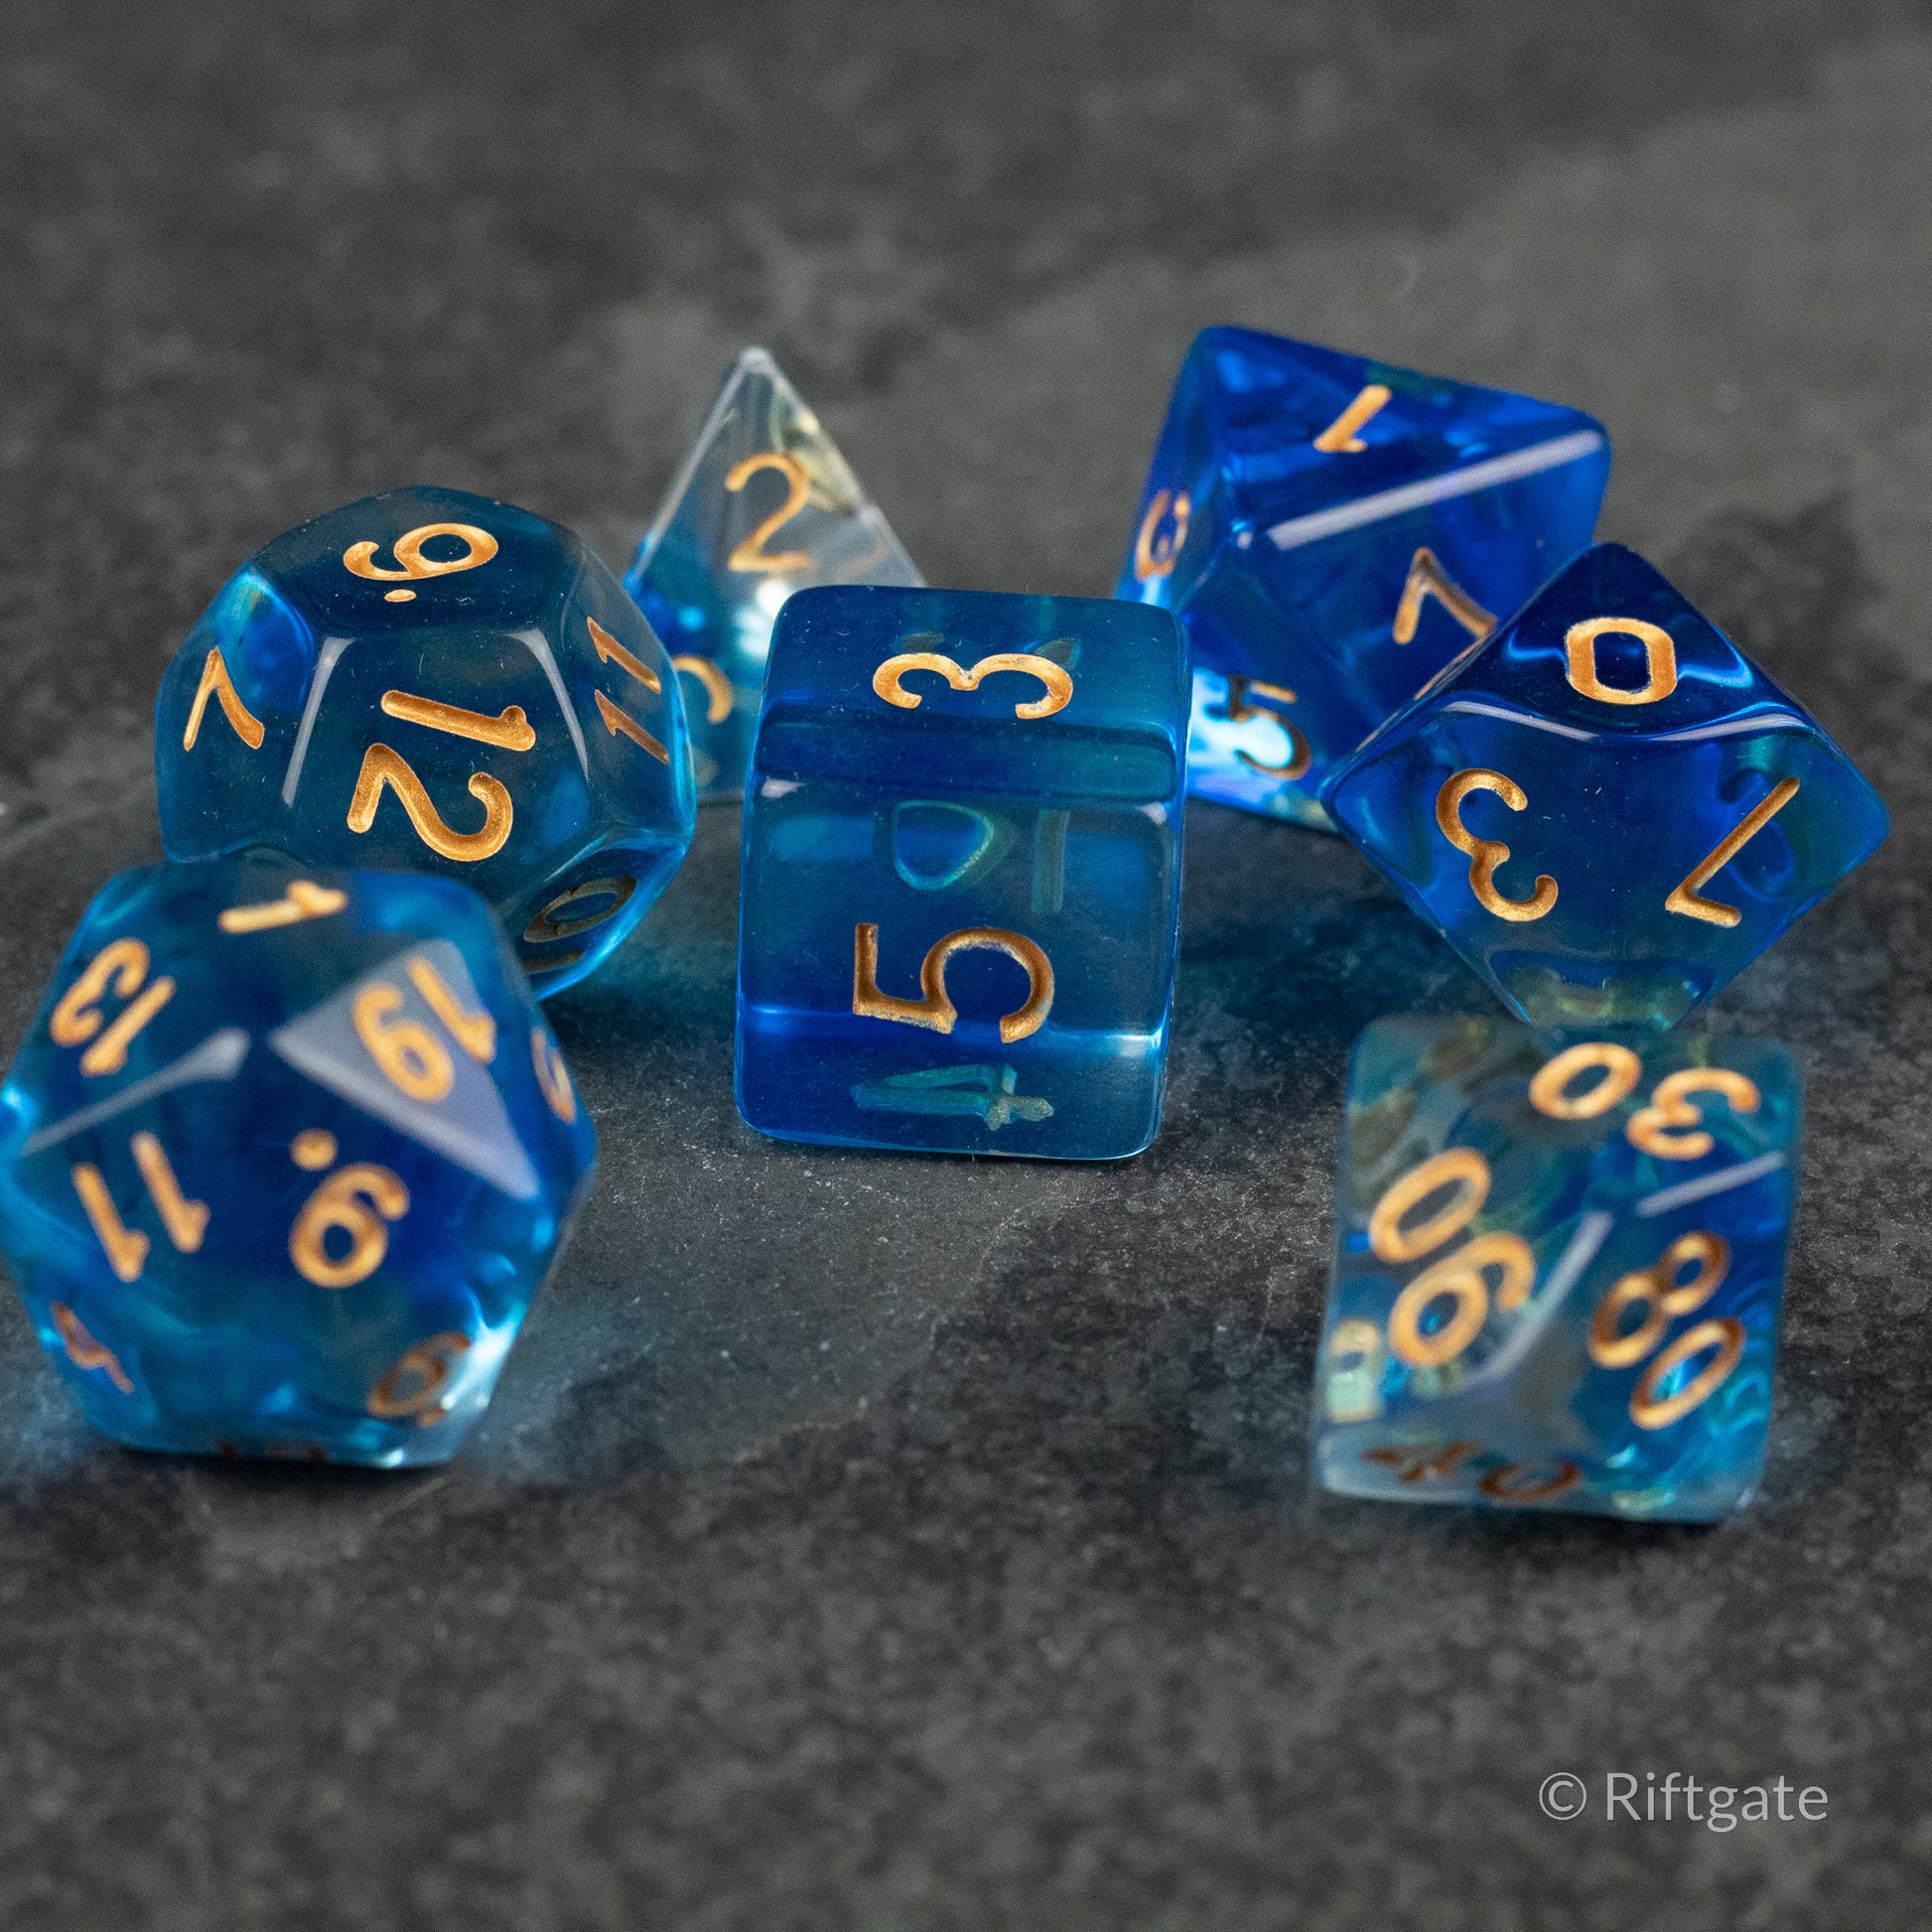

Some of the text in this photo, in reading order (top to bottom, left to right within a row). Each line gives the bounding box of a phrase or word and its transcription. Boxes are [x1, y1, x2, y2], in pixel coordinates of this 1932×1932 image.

[724, 452, 818, 573] 2
[182, 646, 265, 753] 7
[586, 616, 670, 764] 11
[872, 651, 1074, 721] 3
[345, 688, 537, 863] 12
[1435, 767, 1560, 923] 3
[218, 879, 346, 934] 1
[1664, 776, 1801, 927] 7
[50, 938, 176, 1077] 13
[351, 957, 495, 1104] 19
[852, 922, 1055, 1044] 5
[1528, 1041, 1760, 1160] 30
[71, 1134, 210, 1282] 11
[1588, 1231, 1745, 1430] 80
